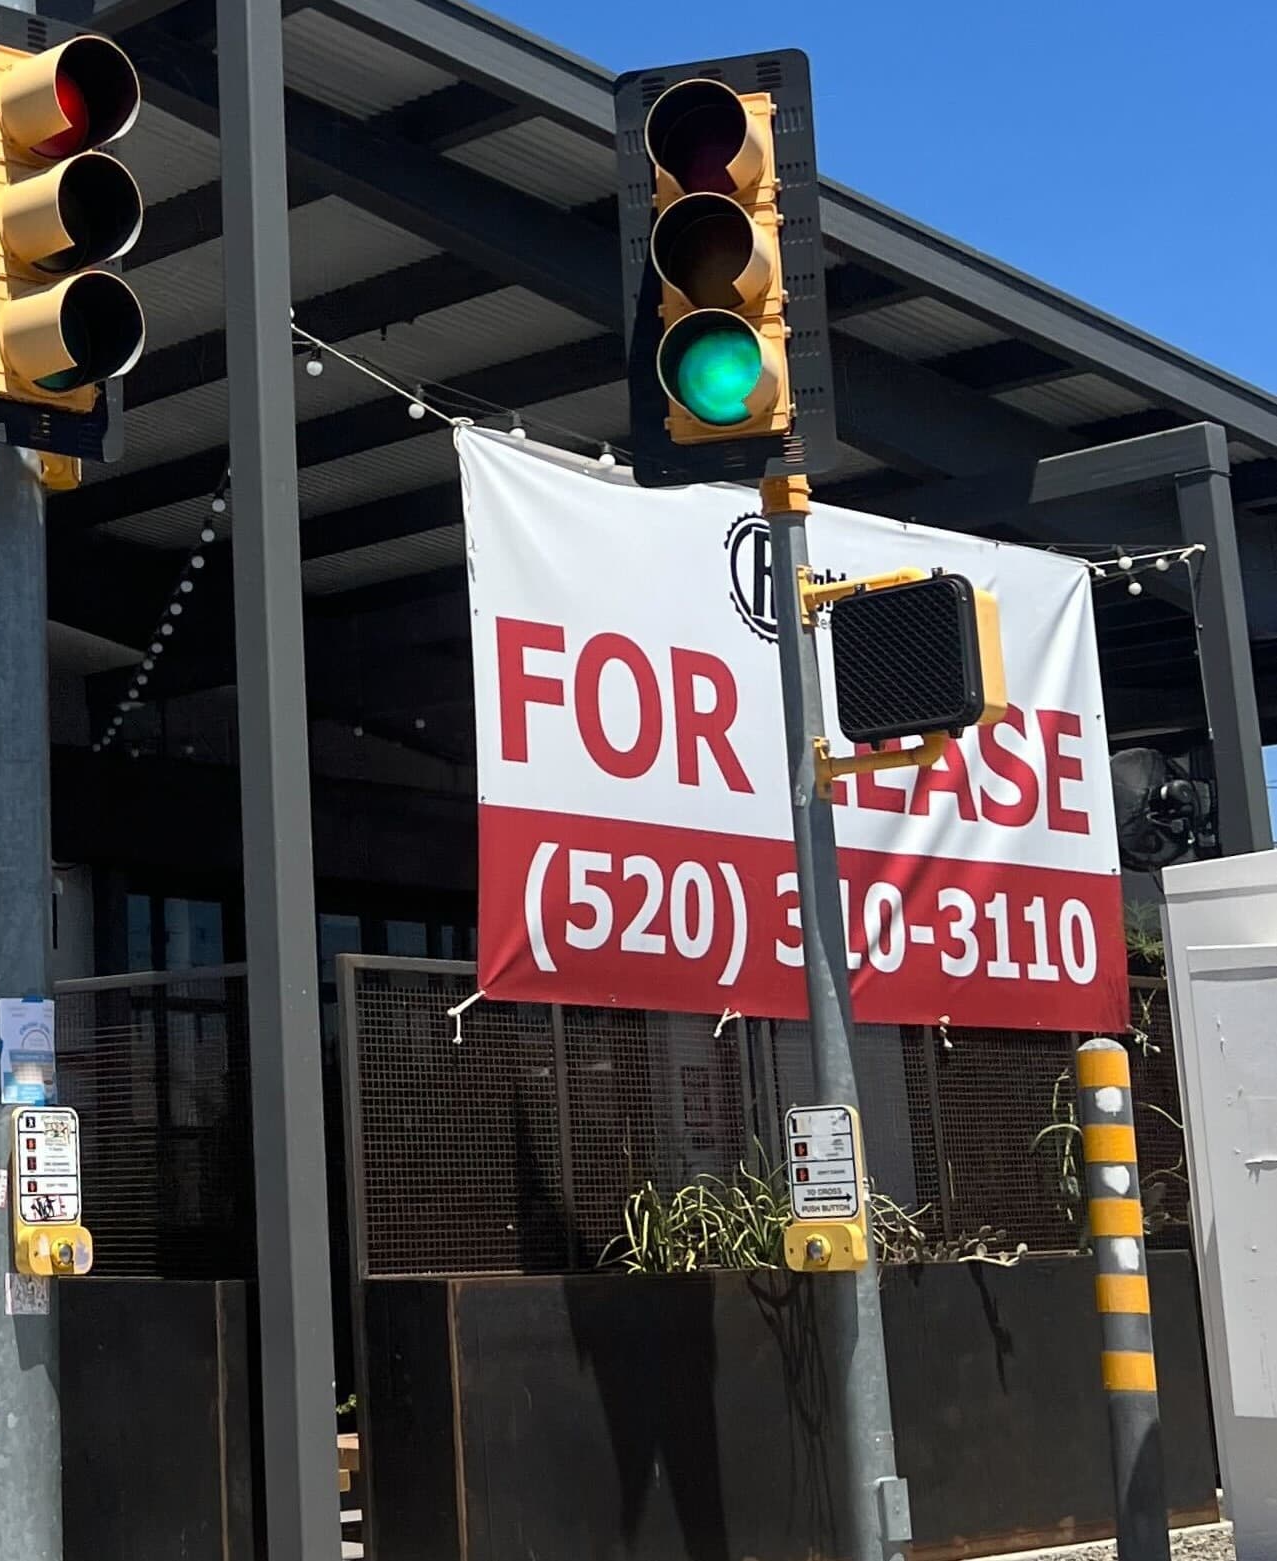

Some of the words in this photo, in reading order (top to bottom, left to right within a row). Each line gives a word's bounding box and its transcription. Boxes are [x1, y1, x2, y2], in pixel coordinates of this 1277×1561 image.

[495, 616, 755, 794] FOR
[831, 702, 1090, 835] ASE
[524, 841, 748, 986] (520)
[821, 1203, 850, 1211] BUTTON
